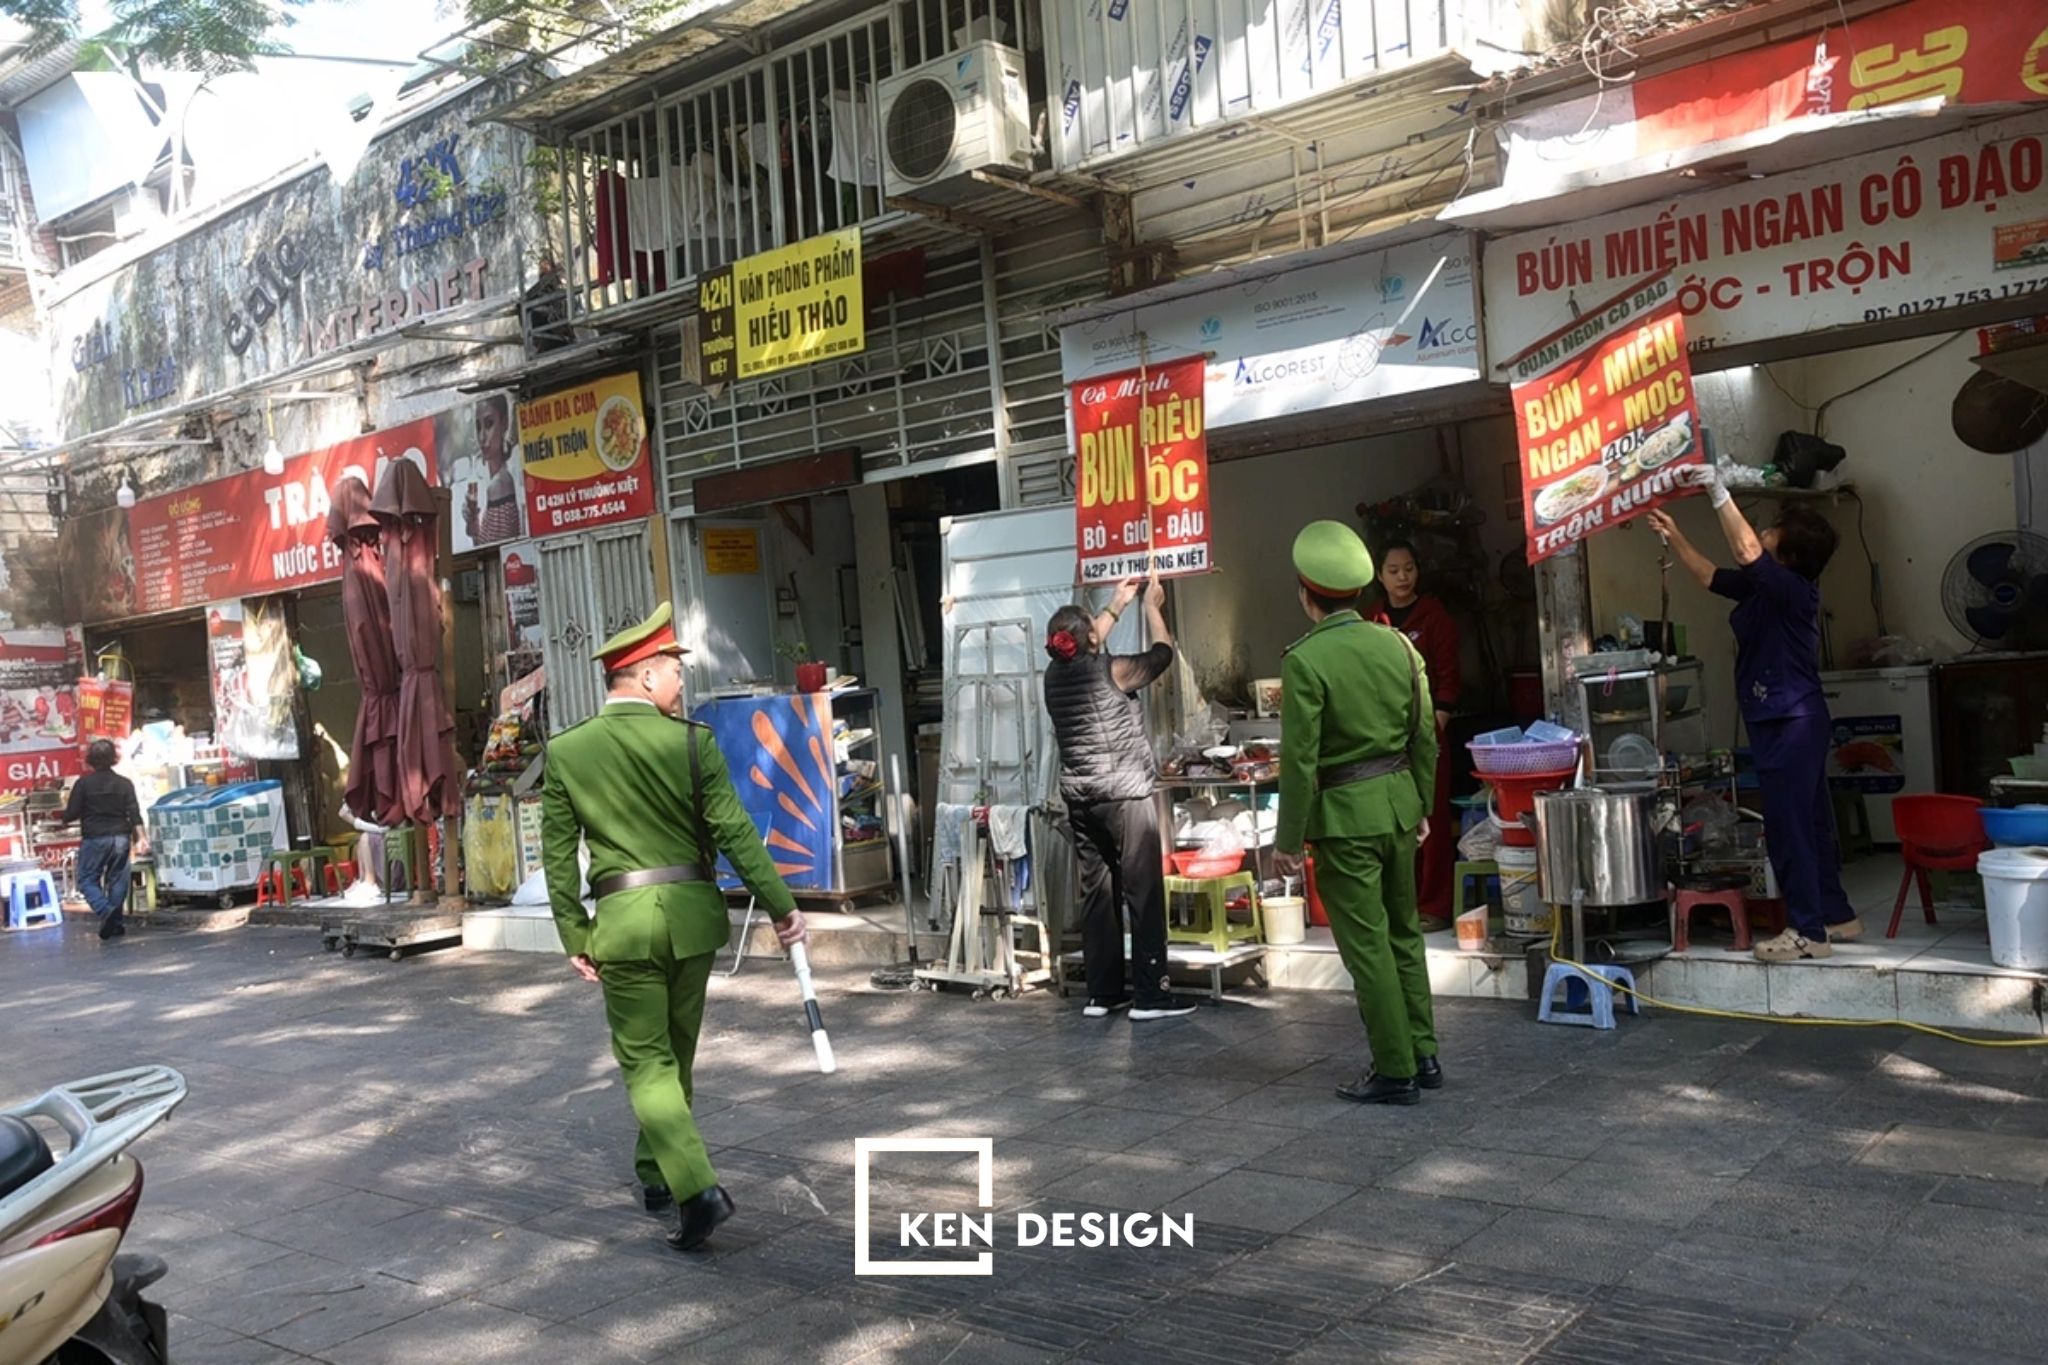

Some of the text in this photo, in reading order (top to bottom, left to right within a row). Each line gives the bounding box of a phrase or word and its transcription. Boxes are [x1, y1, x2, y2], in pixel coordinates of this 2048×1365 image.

[1516, 138, 2043, 296] BÚN MIẾN NGAN CÔ ĐẠO
[700, 275, 732, 313] 42H
[740, 240, 855, 305] VĂN PHÒNG PHẨM
[1783, 241, 1912, 295] TRỘN
[302, 256, 489, 358] INTERNET
[749, 289, 848, 347] HIẾU THẢO
[1081, 386, 1107, 405] Cô
[1524, 317, 1680, 440] BÚN MIẾN
[520, 391, 598, 430] BÁNH ĐA CUA
[1140, 393, 1201, 448] RIÊU
[1528, 370, 1687, 480] NGAN MỌC
[524, 427, 588, 463] MIẾN TRỘN
[1081, 411, 1200, 508] BÚN ỐC
[264, 466, 332, 530] TRÀ
[566, 487, 577, 504] LÝ
[617, 476, 639, 495] KIỆT
[1083, 520, 1107, 551] BÒ
[1167, 507, 1205, 543] ĐẬU
[1535, 504, 1604, 555] TRỘN
[272, 541, 319, 581] NƯỚC
[1084, 548, 1205, 579] 42P LÝ THƯNG KIỆT
[7, 756, 60, 781] GIẢI
